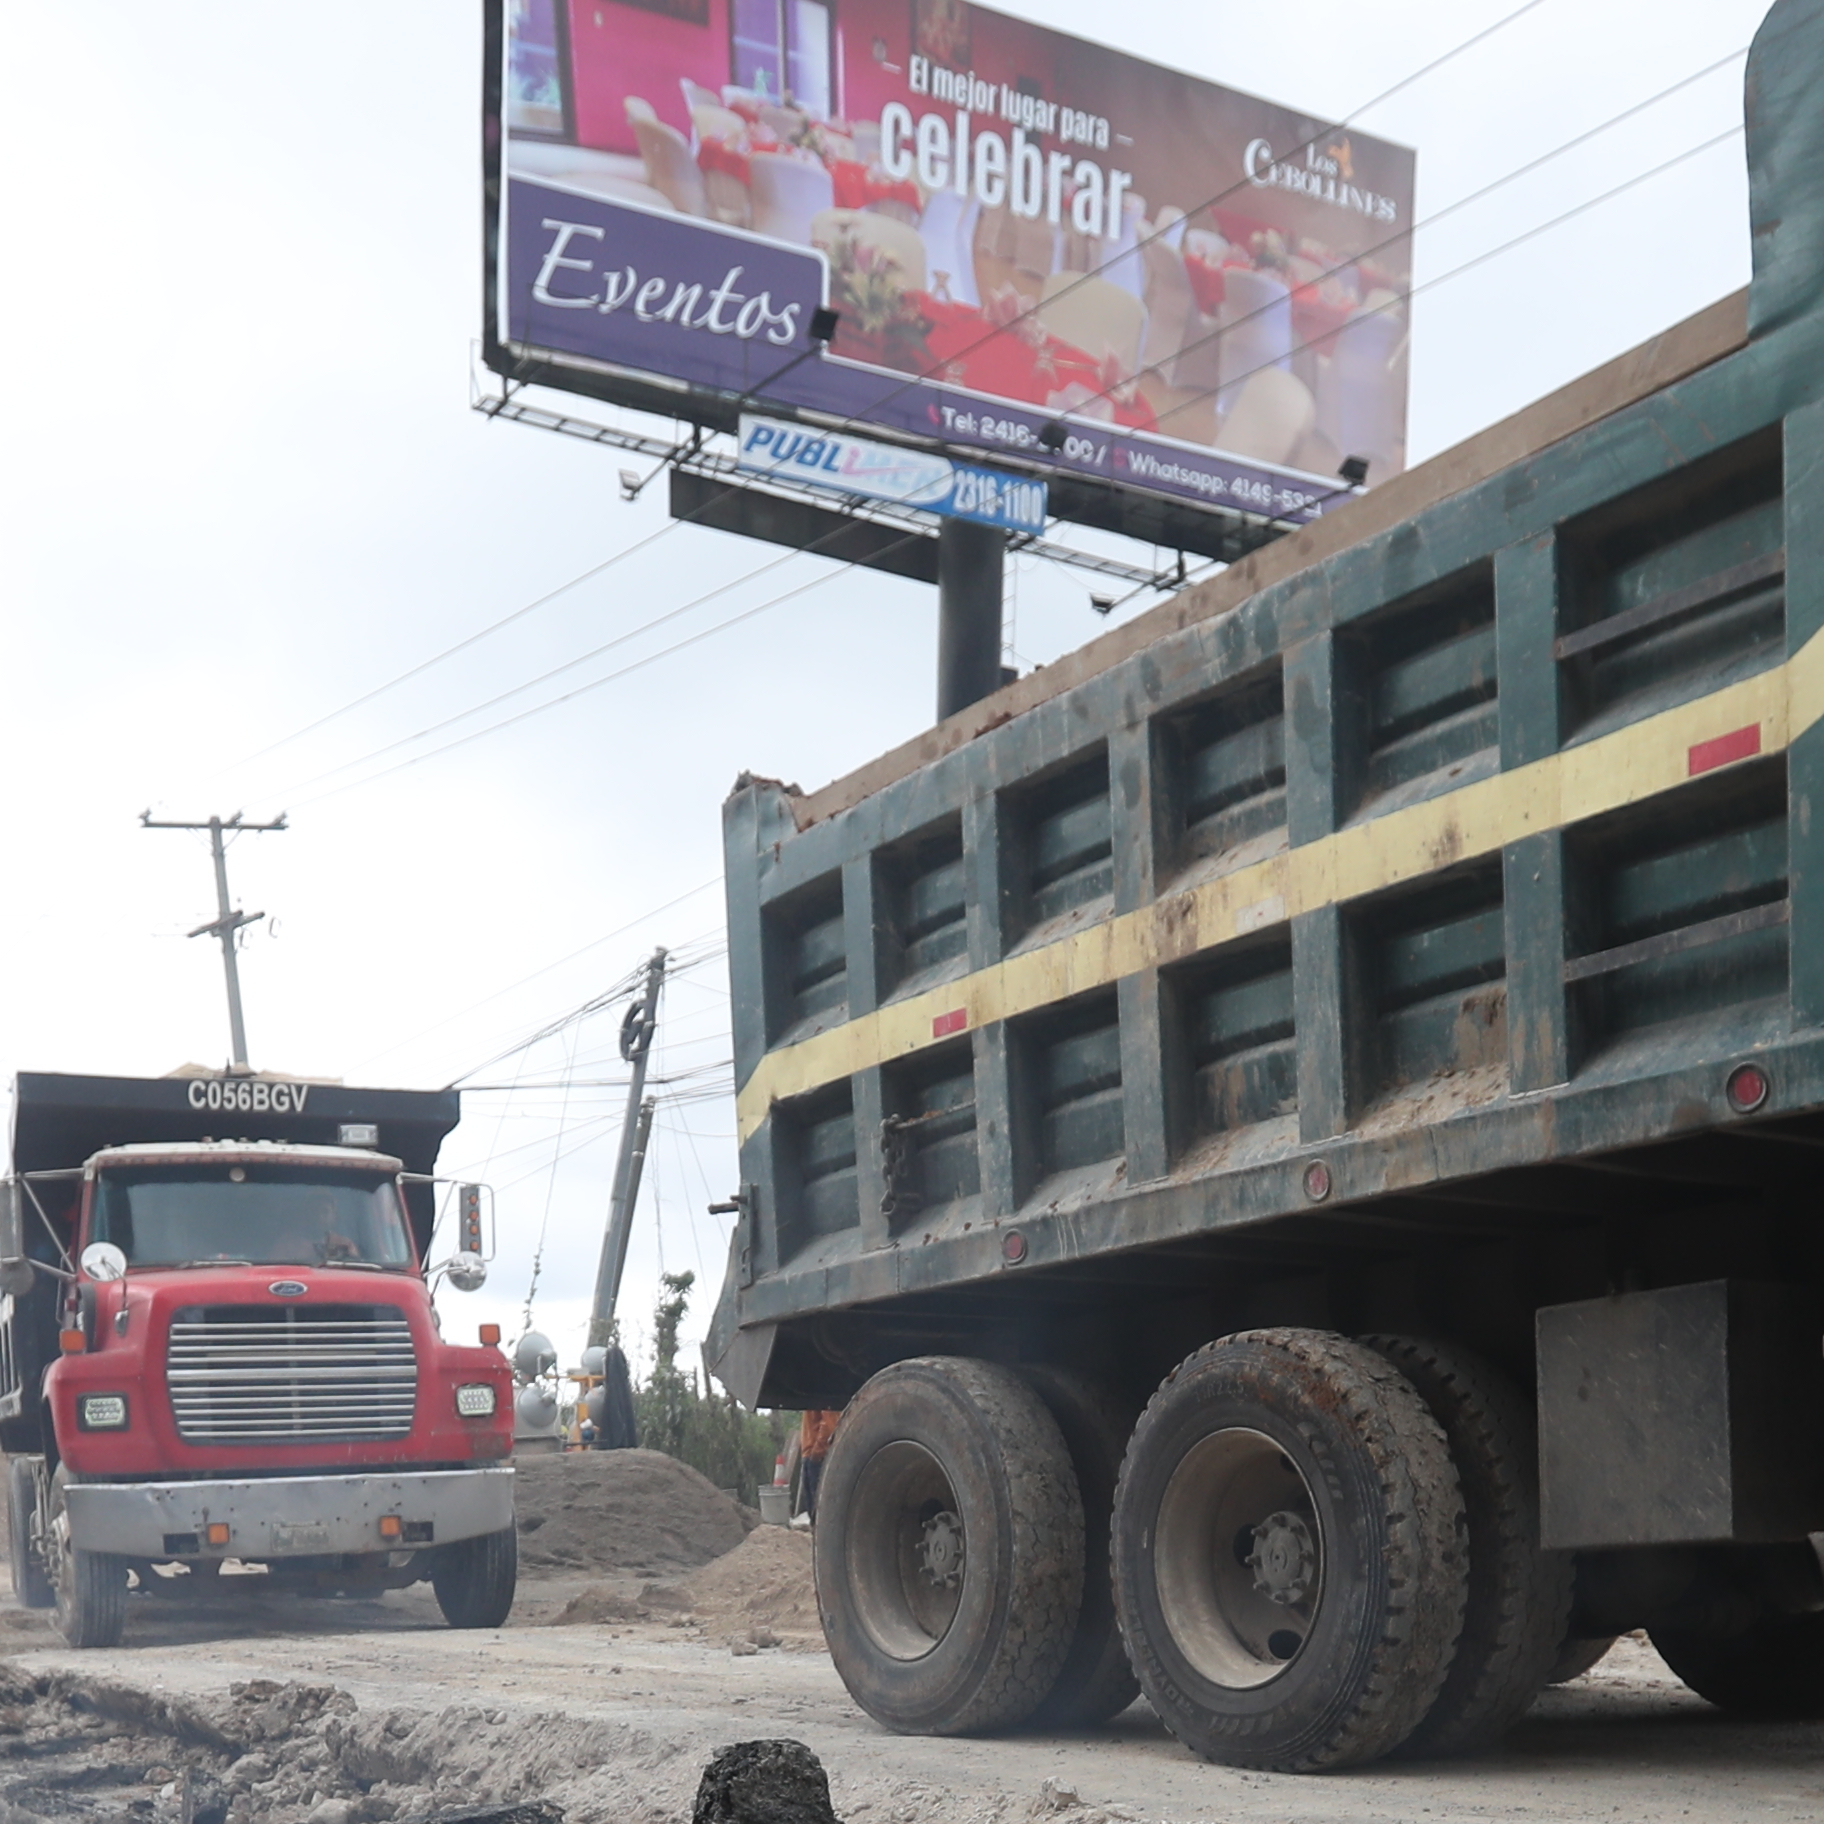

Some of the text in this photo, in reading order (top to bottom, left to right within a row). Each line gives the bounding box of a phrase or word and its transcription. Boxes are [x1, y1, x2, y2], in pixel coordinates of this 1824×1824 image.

[908, 54, 1110, 151] El mejor lugar para
[880, 101, 1132, 240] celebrar
[532, 217, 801, 346] Eventos
[941, 406, 977, 434] Tel:
[979, 416, 1094, 464] 2416-00
[1128, 451, 1228, 496] Whatsapp:
[187, 1080, 309, 1112] C056BGV
